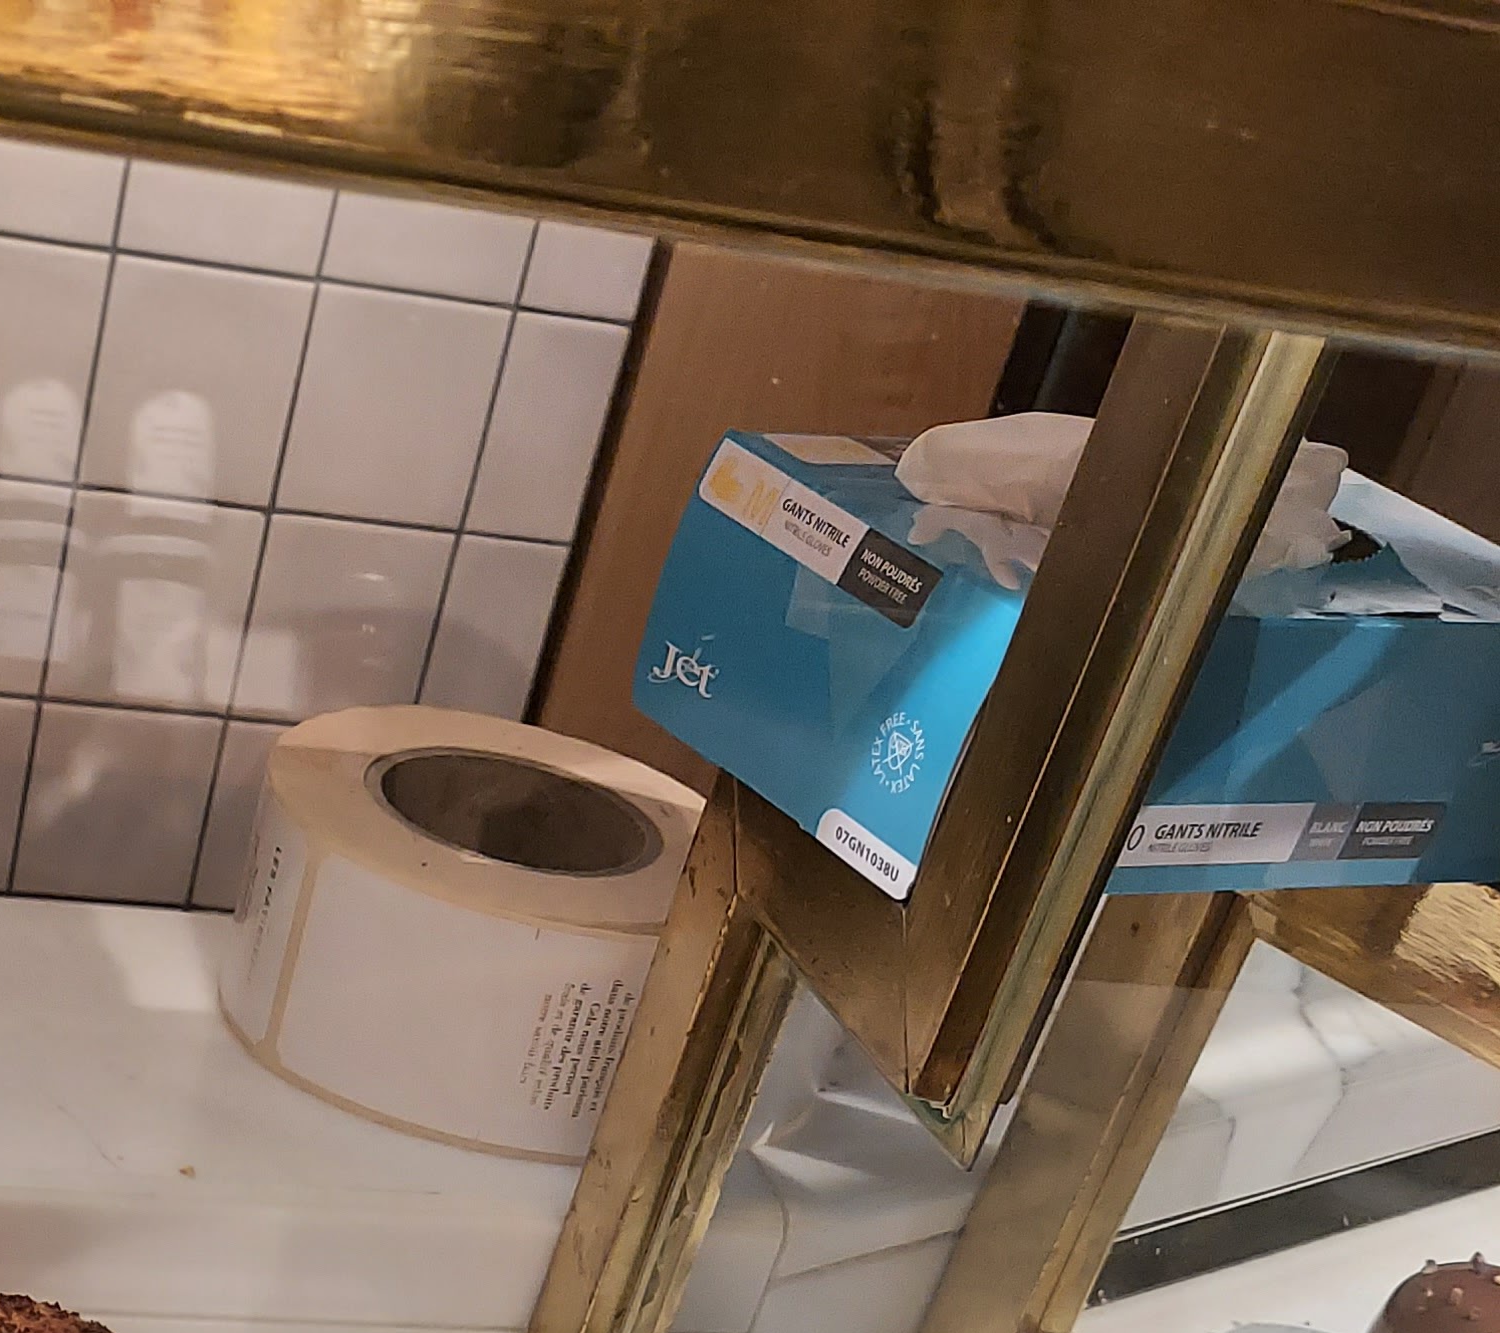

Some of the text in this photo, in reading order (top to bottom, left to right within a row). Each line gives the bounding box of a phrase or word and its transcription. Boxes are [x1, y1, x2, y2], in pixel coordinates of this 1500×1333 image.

[783, 499, 851, 548] GANTS NITRILE
[860, 549, 923, 593] NON POUDRÉS
[879, 712, 906, 737] FREE
[891, 720, 926, 794] SANS LATEX
[834, 825, 900, 883] 07GN1038U
[1155, 823, 1206, 840] GANTS
[1205, 822, 1263, 838] NITRILE
